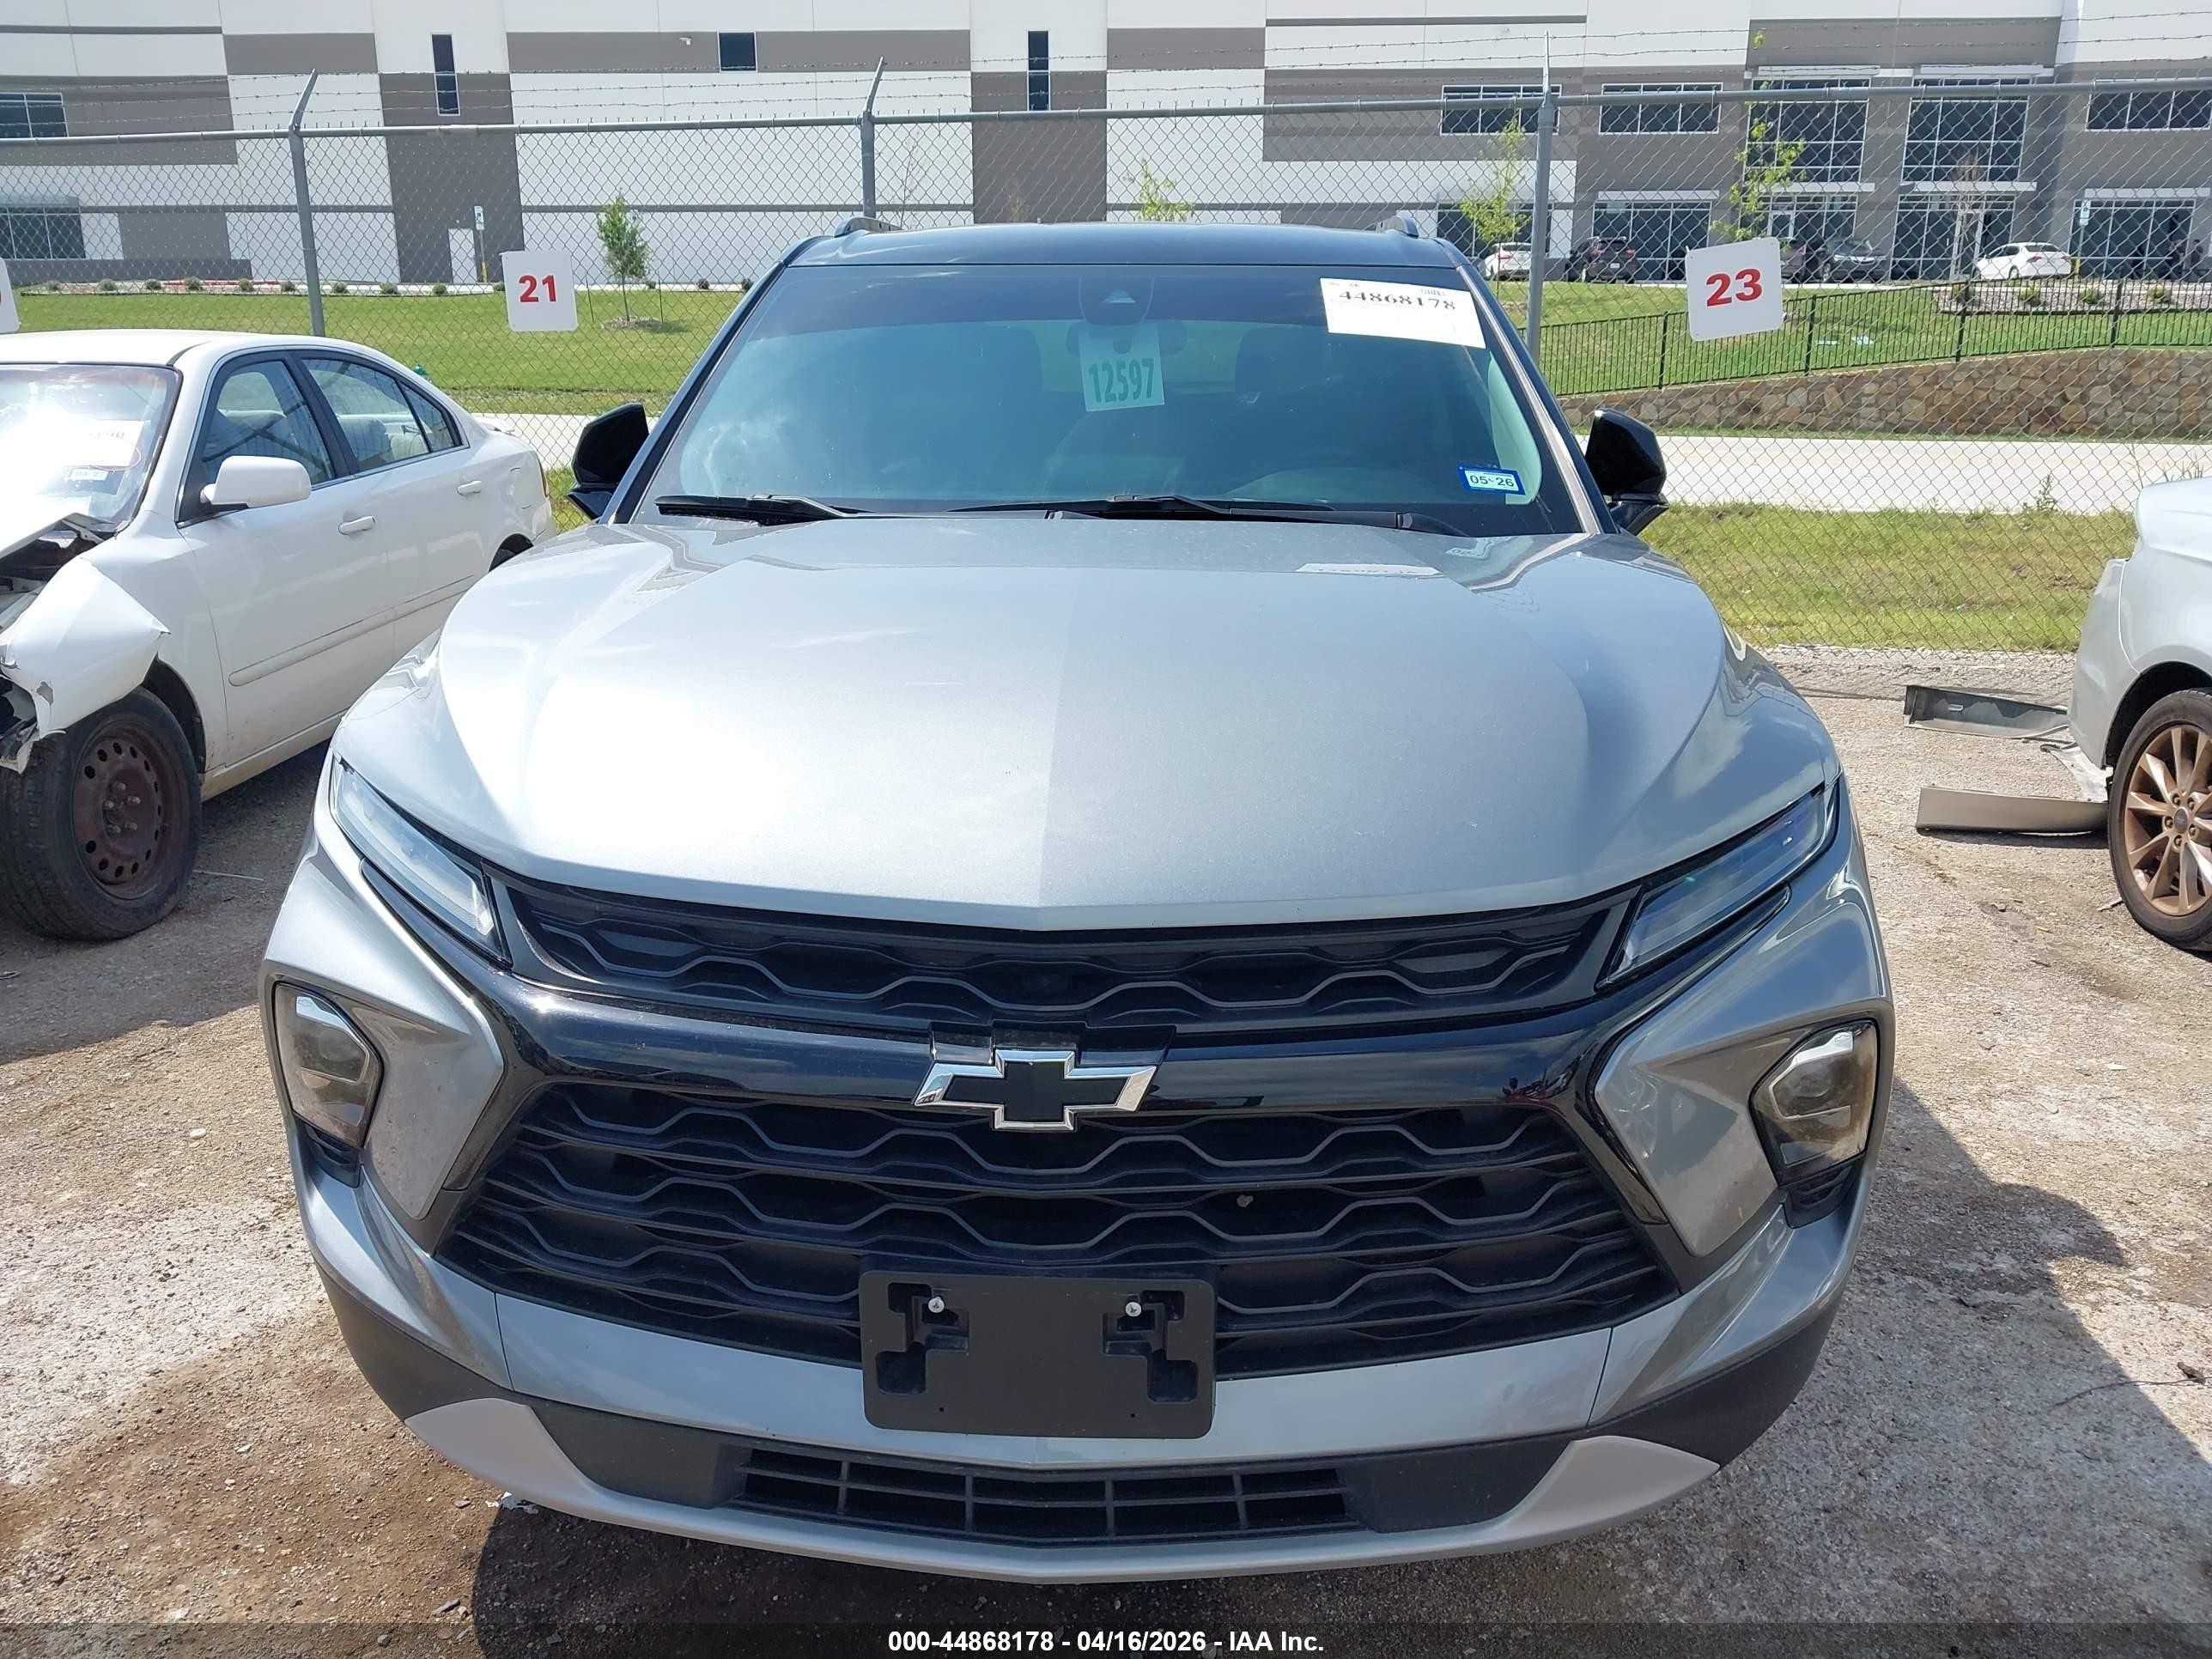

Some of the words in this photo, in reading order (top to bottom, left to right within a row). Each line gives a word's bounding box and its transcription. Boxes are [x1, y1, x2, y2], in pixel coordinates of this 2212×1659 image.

[518, 275, 556, 303] 21
[1339, 290, 1456, 310] 44868178
[1706, 268, 1763, 307] 23
[1089, 357, 1155, 404] 12597
